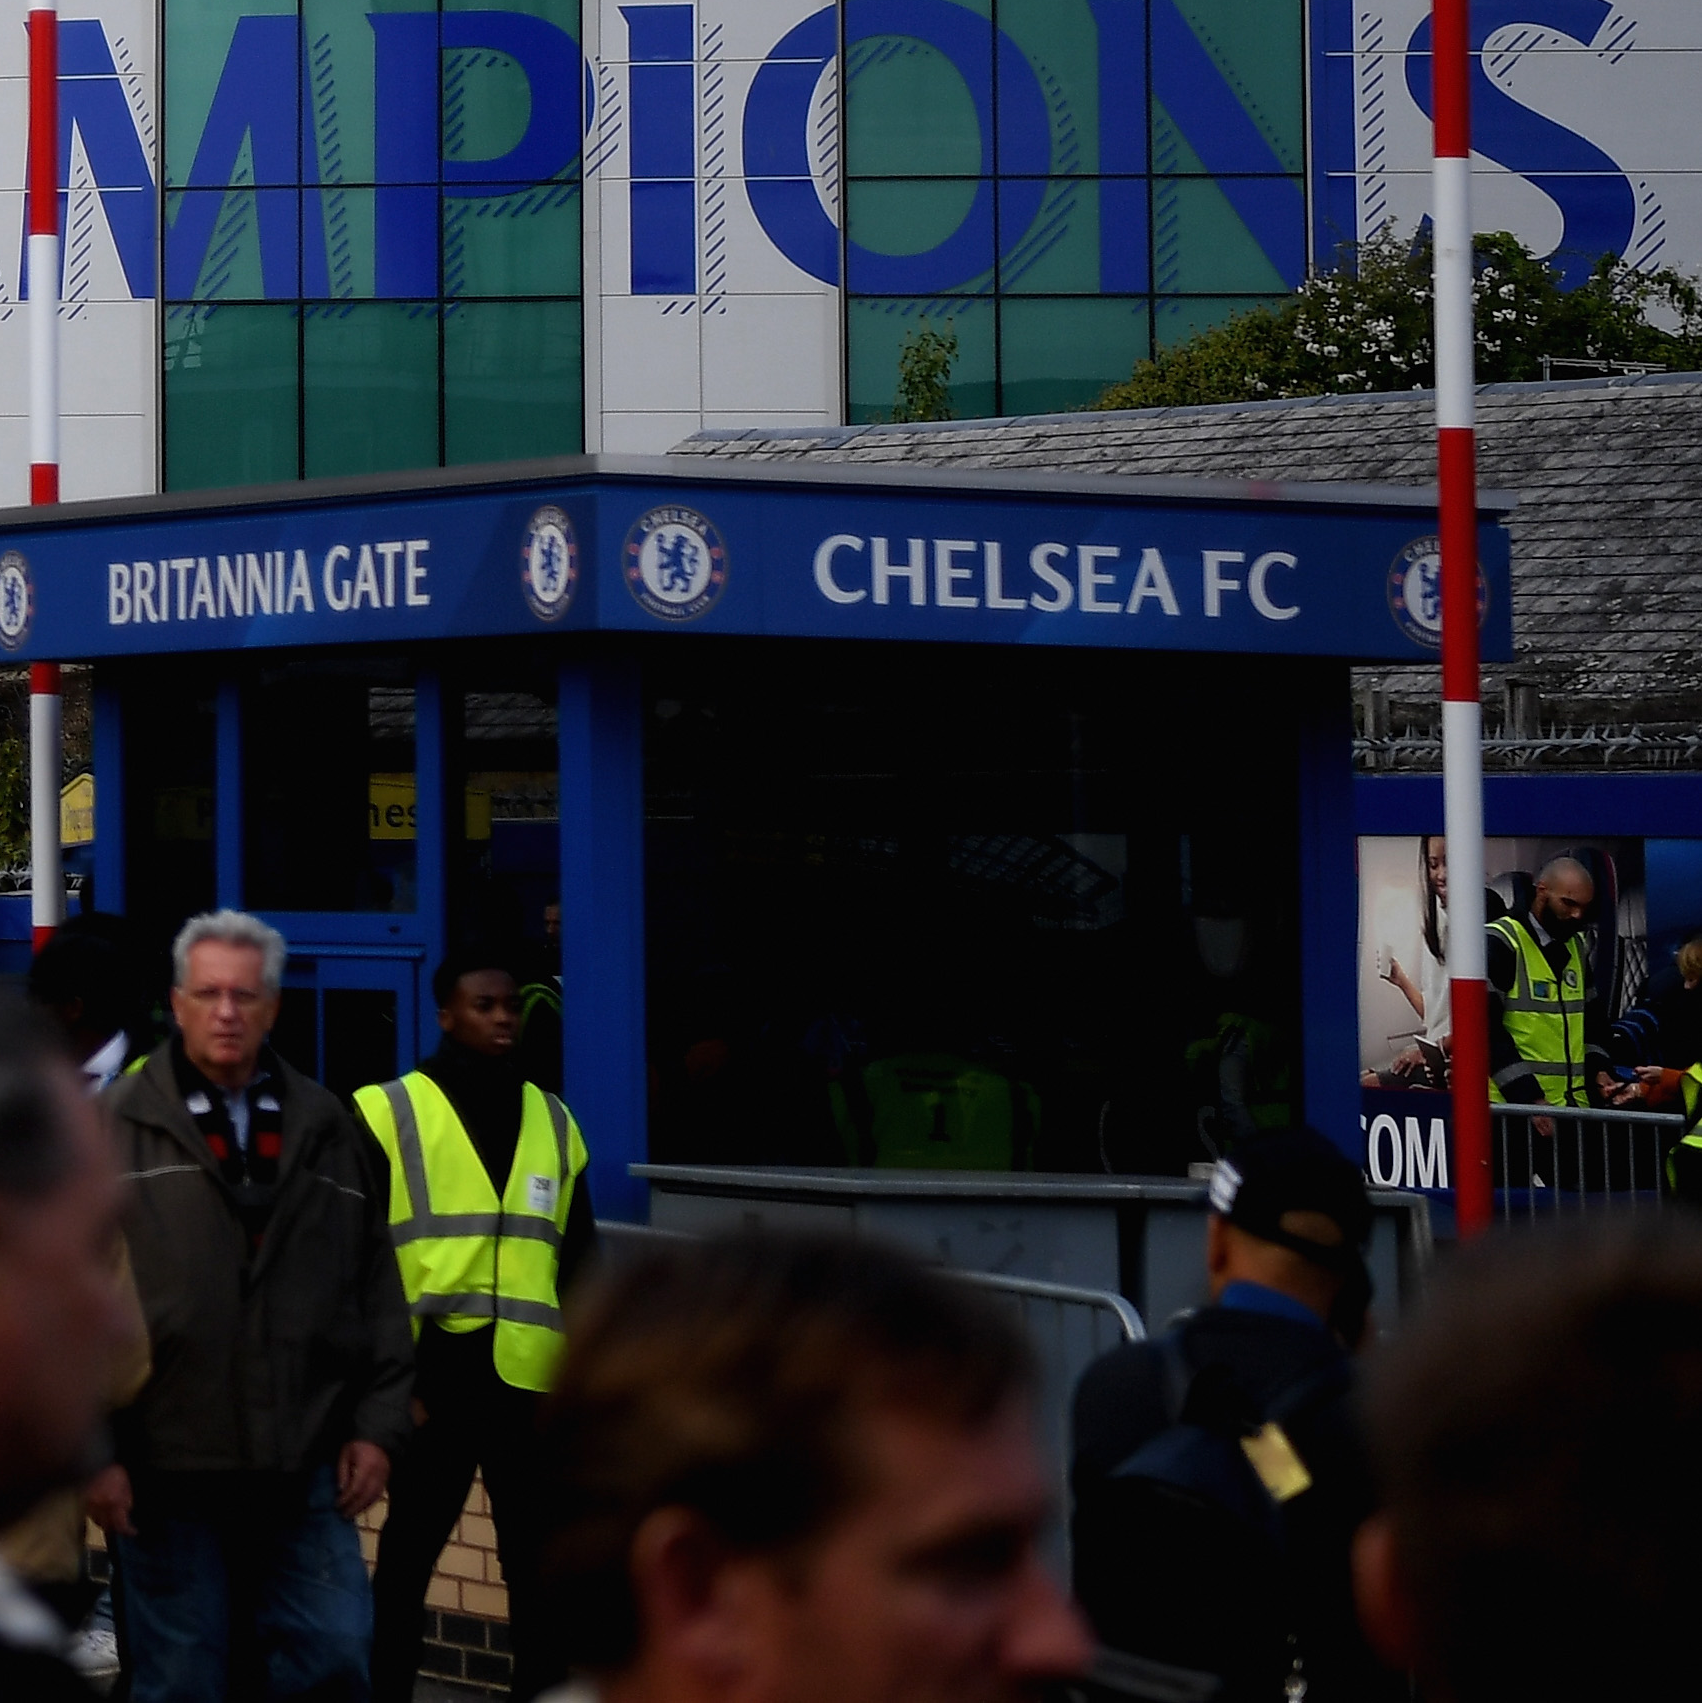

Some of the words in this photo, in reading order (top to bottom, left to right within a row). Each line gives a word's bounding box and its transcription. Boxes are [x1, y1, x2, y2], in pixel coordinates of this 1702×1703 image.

[108, 548, 311, 626] BRITANNIA
[322, 539, 432, 611] GATE
[813, 532, 1182, 618] CHELSEA
[1201, 549, 1303, 622] FC
[1360, 1113, 1449, 1189] OM
